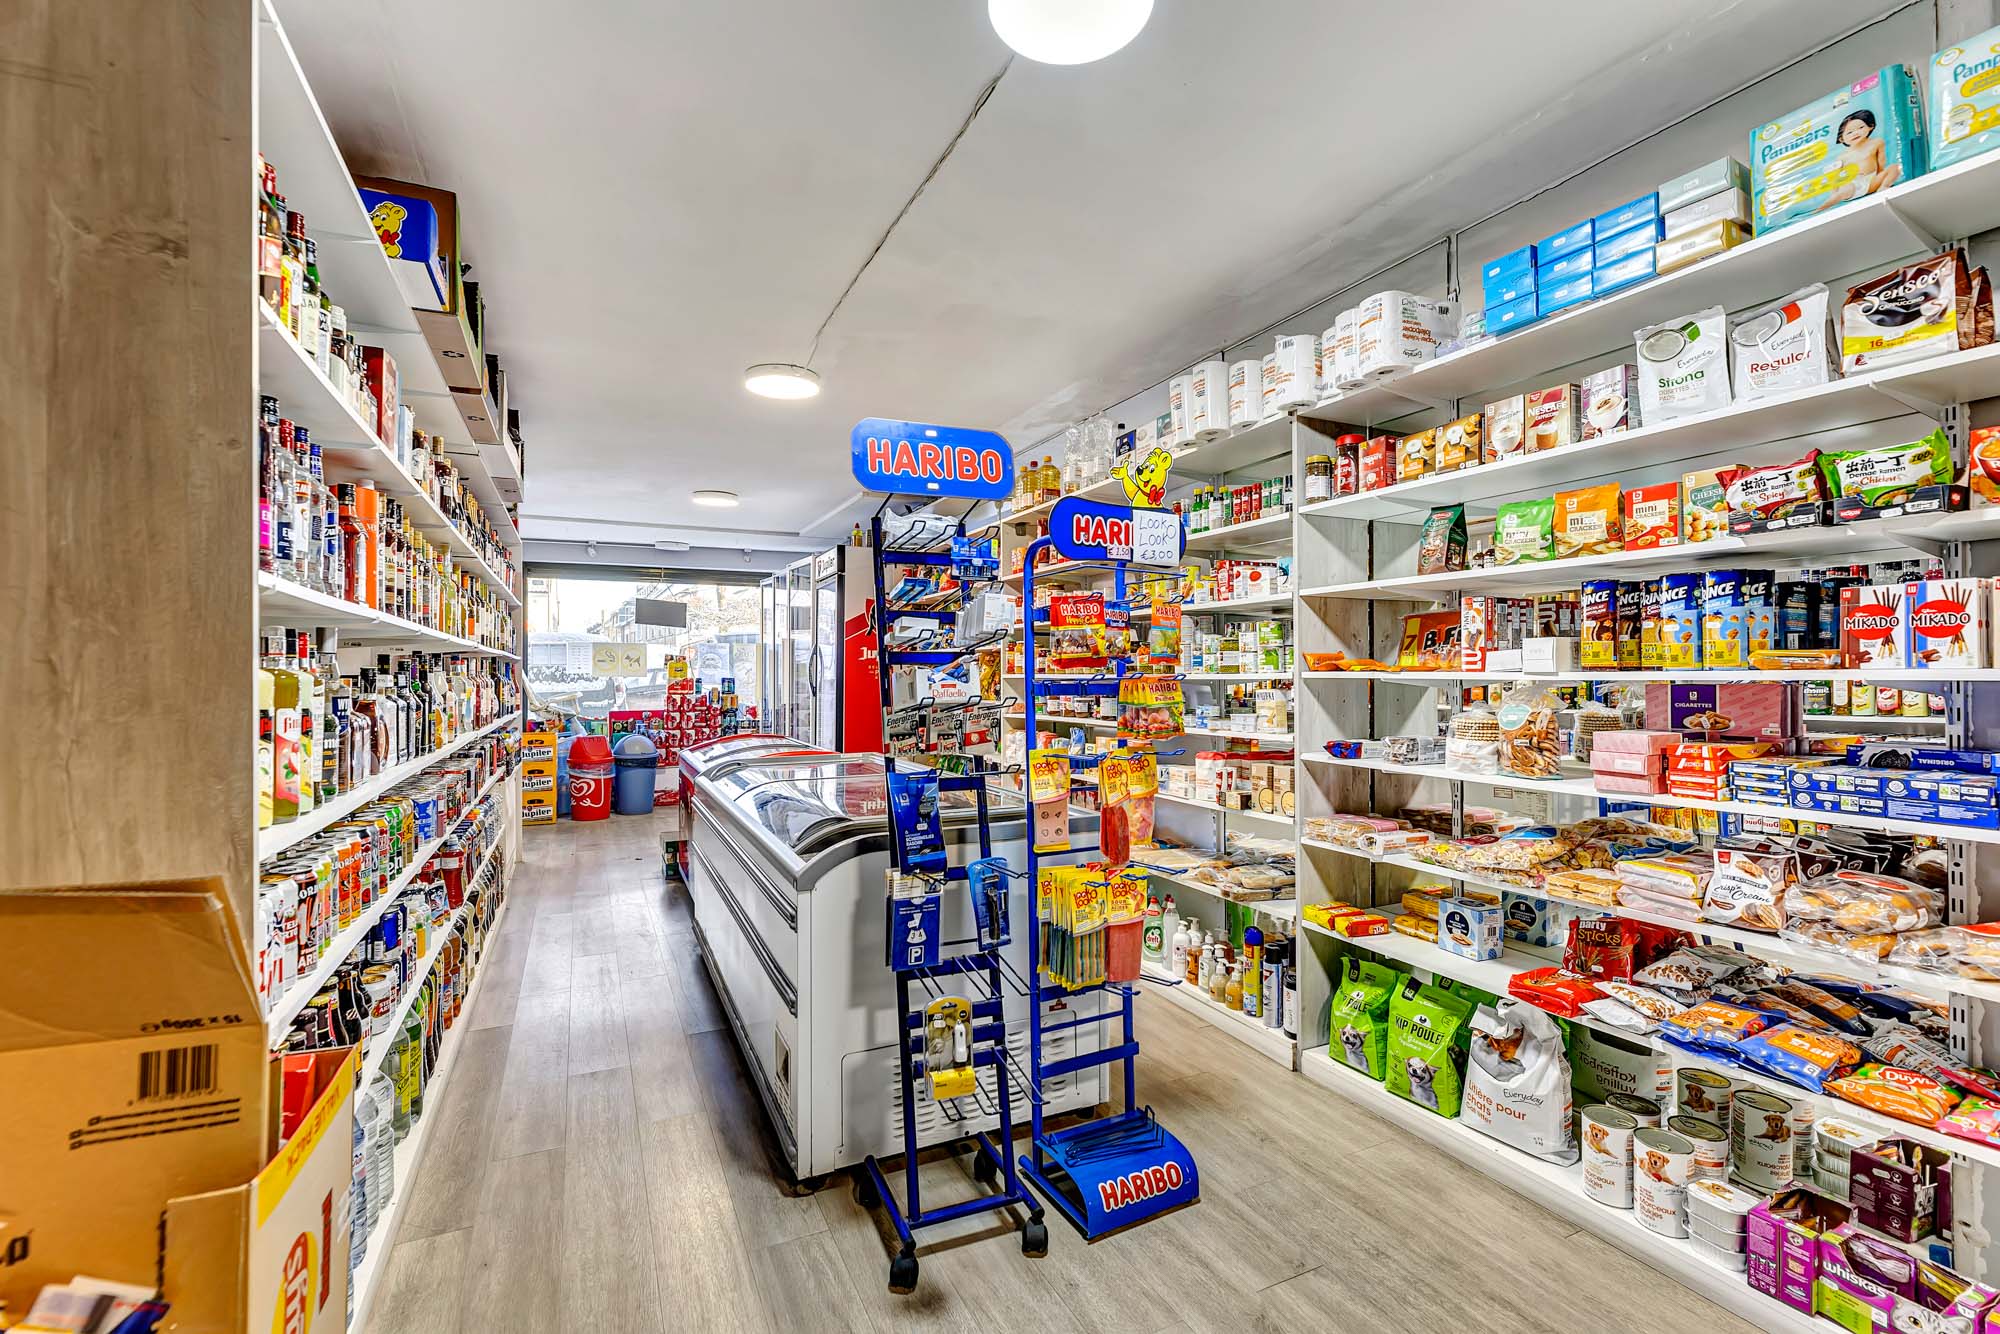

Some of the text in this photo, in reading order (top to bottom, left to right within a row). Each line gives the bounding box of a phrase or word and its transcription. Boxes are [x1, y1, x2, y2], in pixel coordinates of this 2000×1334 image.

[1860, 269, 1941, 316] Senseo
[1869, 338, 1884, 348] 16
[1750, 350, 1812, 374] Regular
[867, 437, 1002, 484] HARIBO
[1759, 491, 1785, 502] Spicy
[1074, 513, 1133, 548] HARI
[1061, 603, 1100, 616] HARIBO
[1155, 606, 1181, 618] HARIBO
[1844, 615, 1900, 631] MIKADO
[1911, 612, 1971, 627] MIKADO
[1404, 634, 1418, 652] 7
[931, 689, 967, 699] Raffaello
[886, 712, 918, 727] Energizer
[968, 710, 999, 721] Energizer
[1917, 757, 1955, 766] ORIGINAL
[1731, 890, 1773, 903] Cream
[1579, 920, 1607, 932] party
[1146, 934, 1159, 944] dreft
[1578, 929, 1622, 944] STICKS
[911, 948, 922, 963] P
[1467, 1093, 1492, 1116] chats
[1503, 1088, 1544, 1106] Everyday
[1496, 1102, 1527, 1120] pour
[1099, 1162, 1183, 1212] HARIBO
[1822, 1258, 1887, 1299] whiskas
